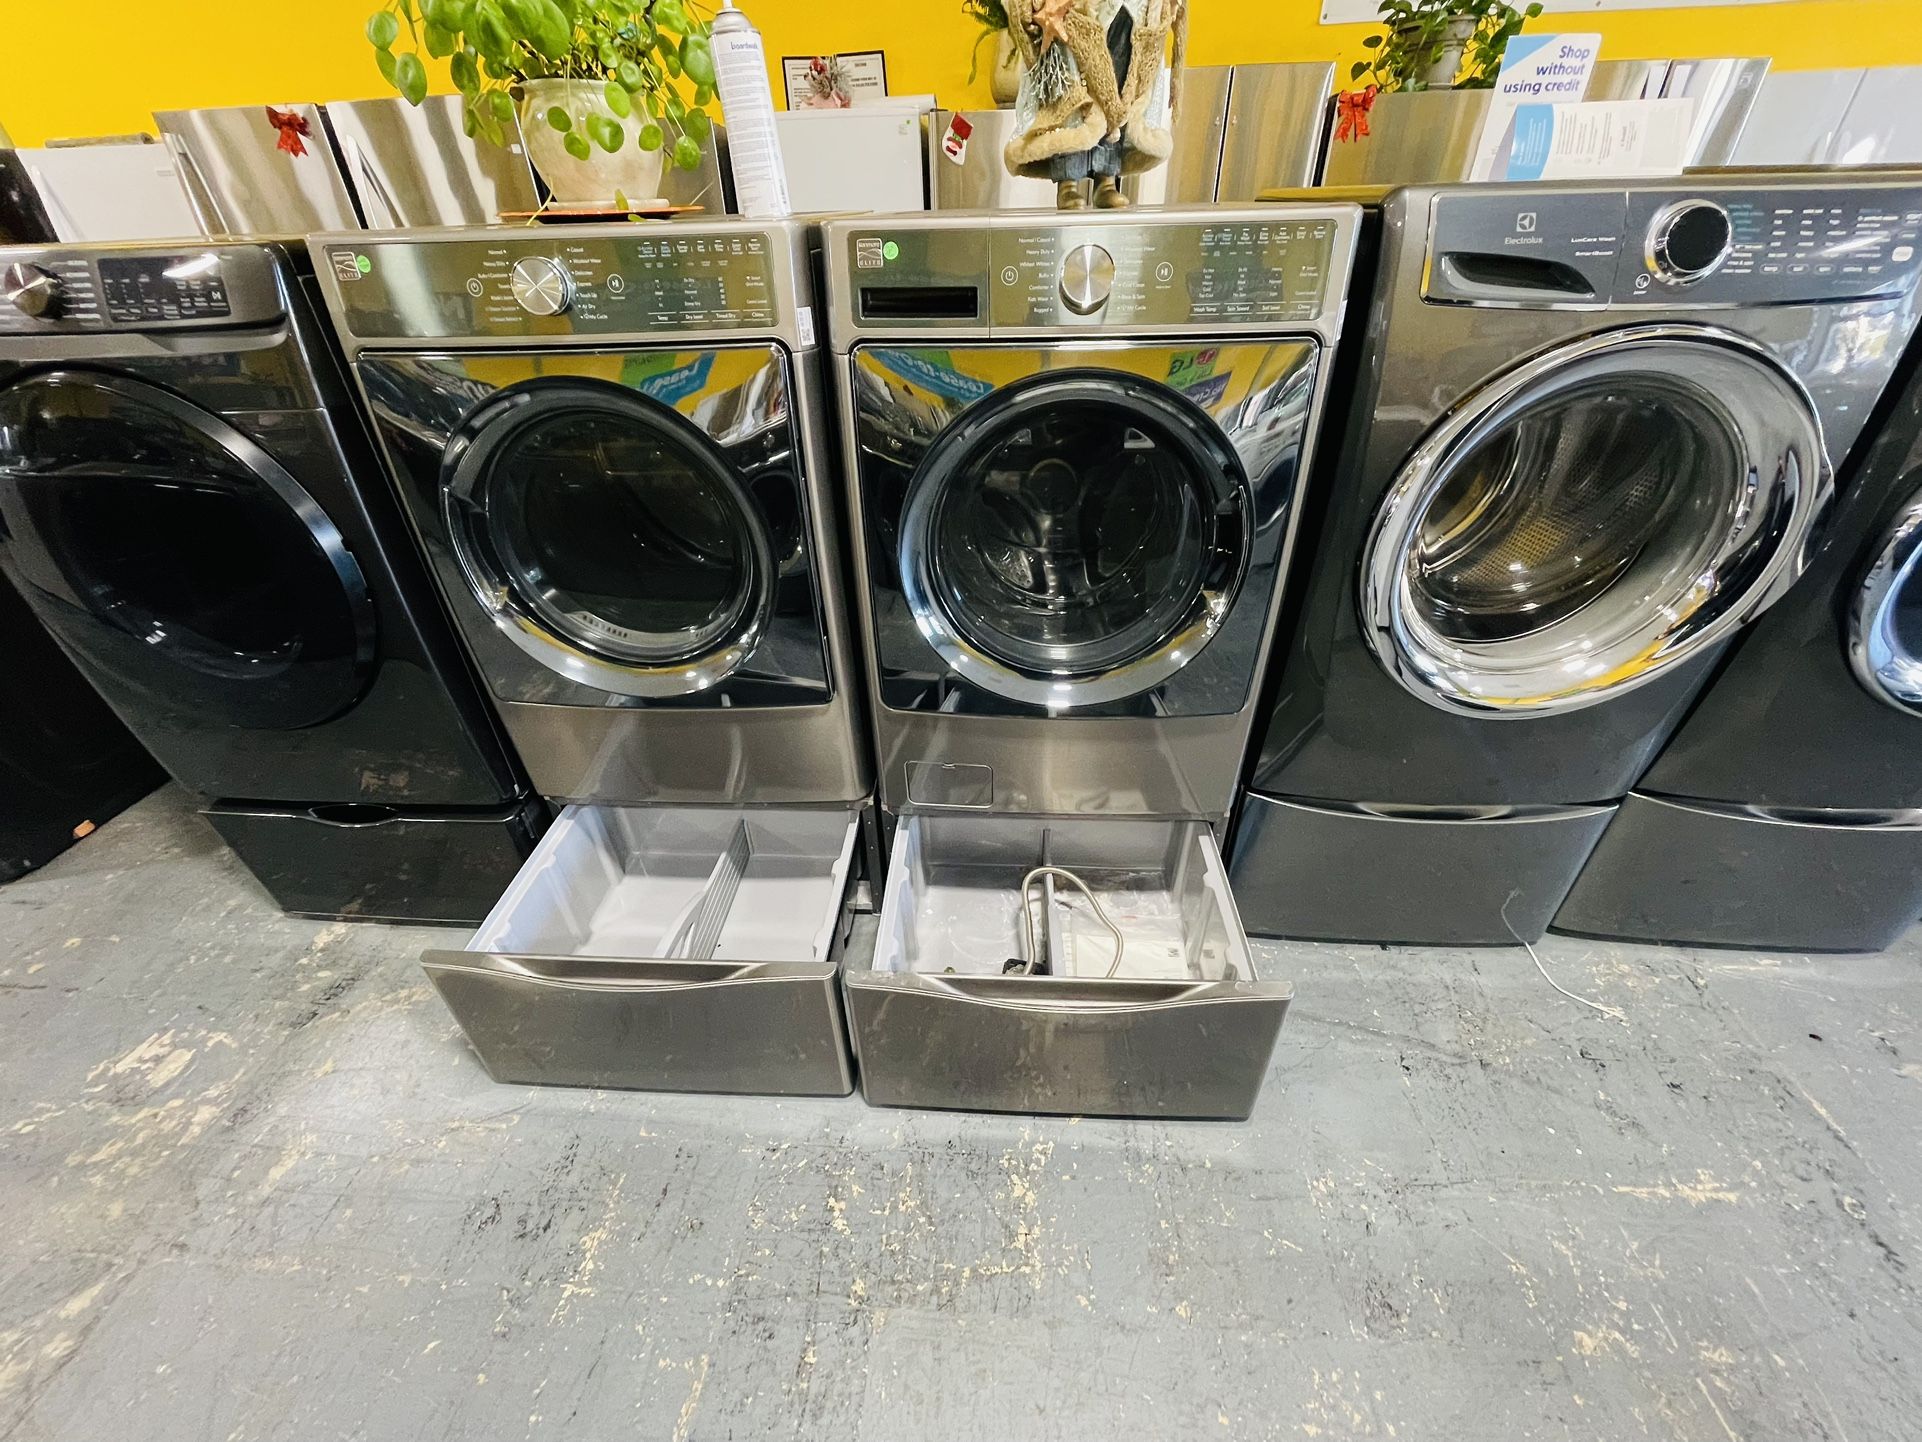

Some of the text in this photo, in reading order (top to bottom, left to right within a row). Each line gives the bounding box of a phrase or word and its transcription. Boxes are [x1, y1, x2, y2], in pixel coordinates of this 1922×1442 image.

[1559, 45, 1590, 60] Shop
[1536, 63, 1585, 76] without
[1503, 79, 1580, 95] using credit
[1504, 236, 1543, 245] Electrolux
